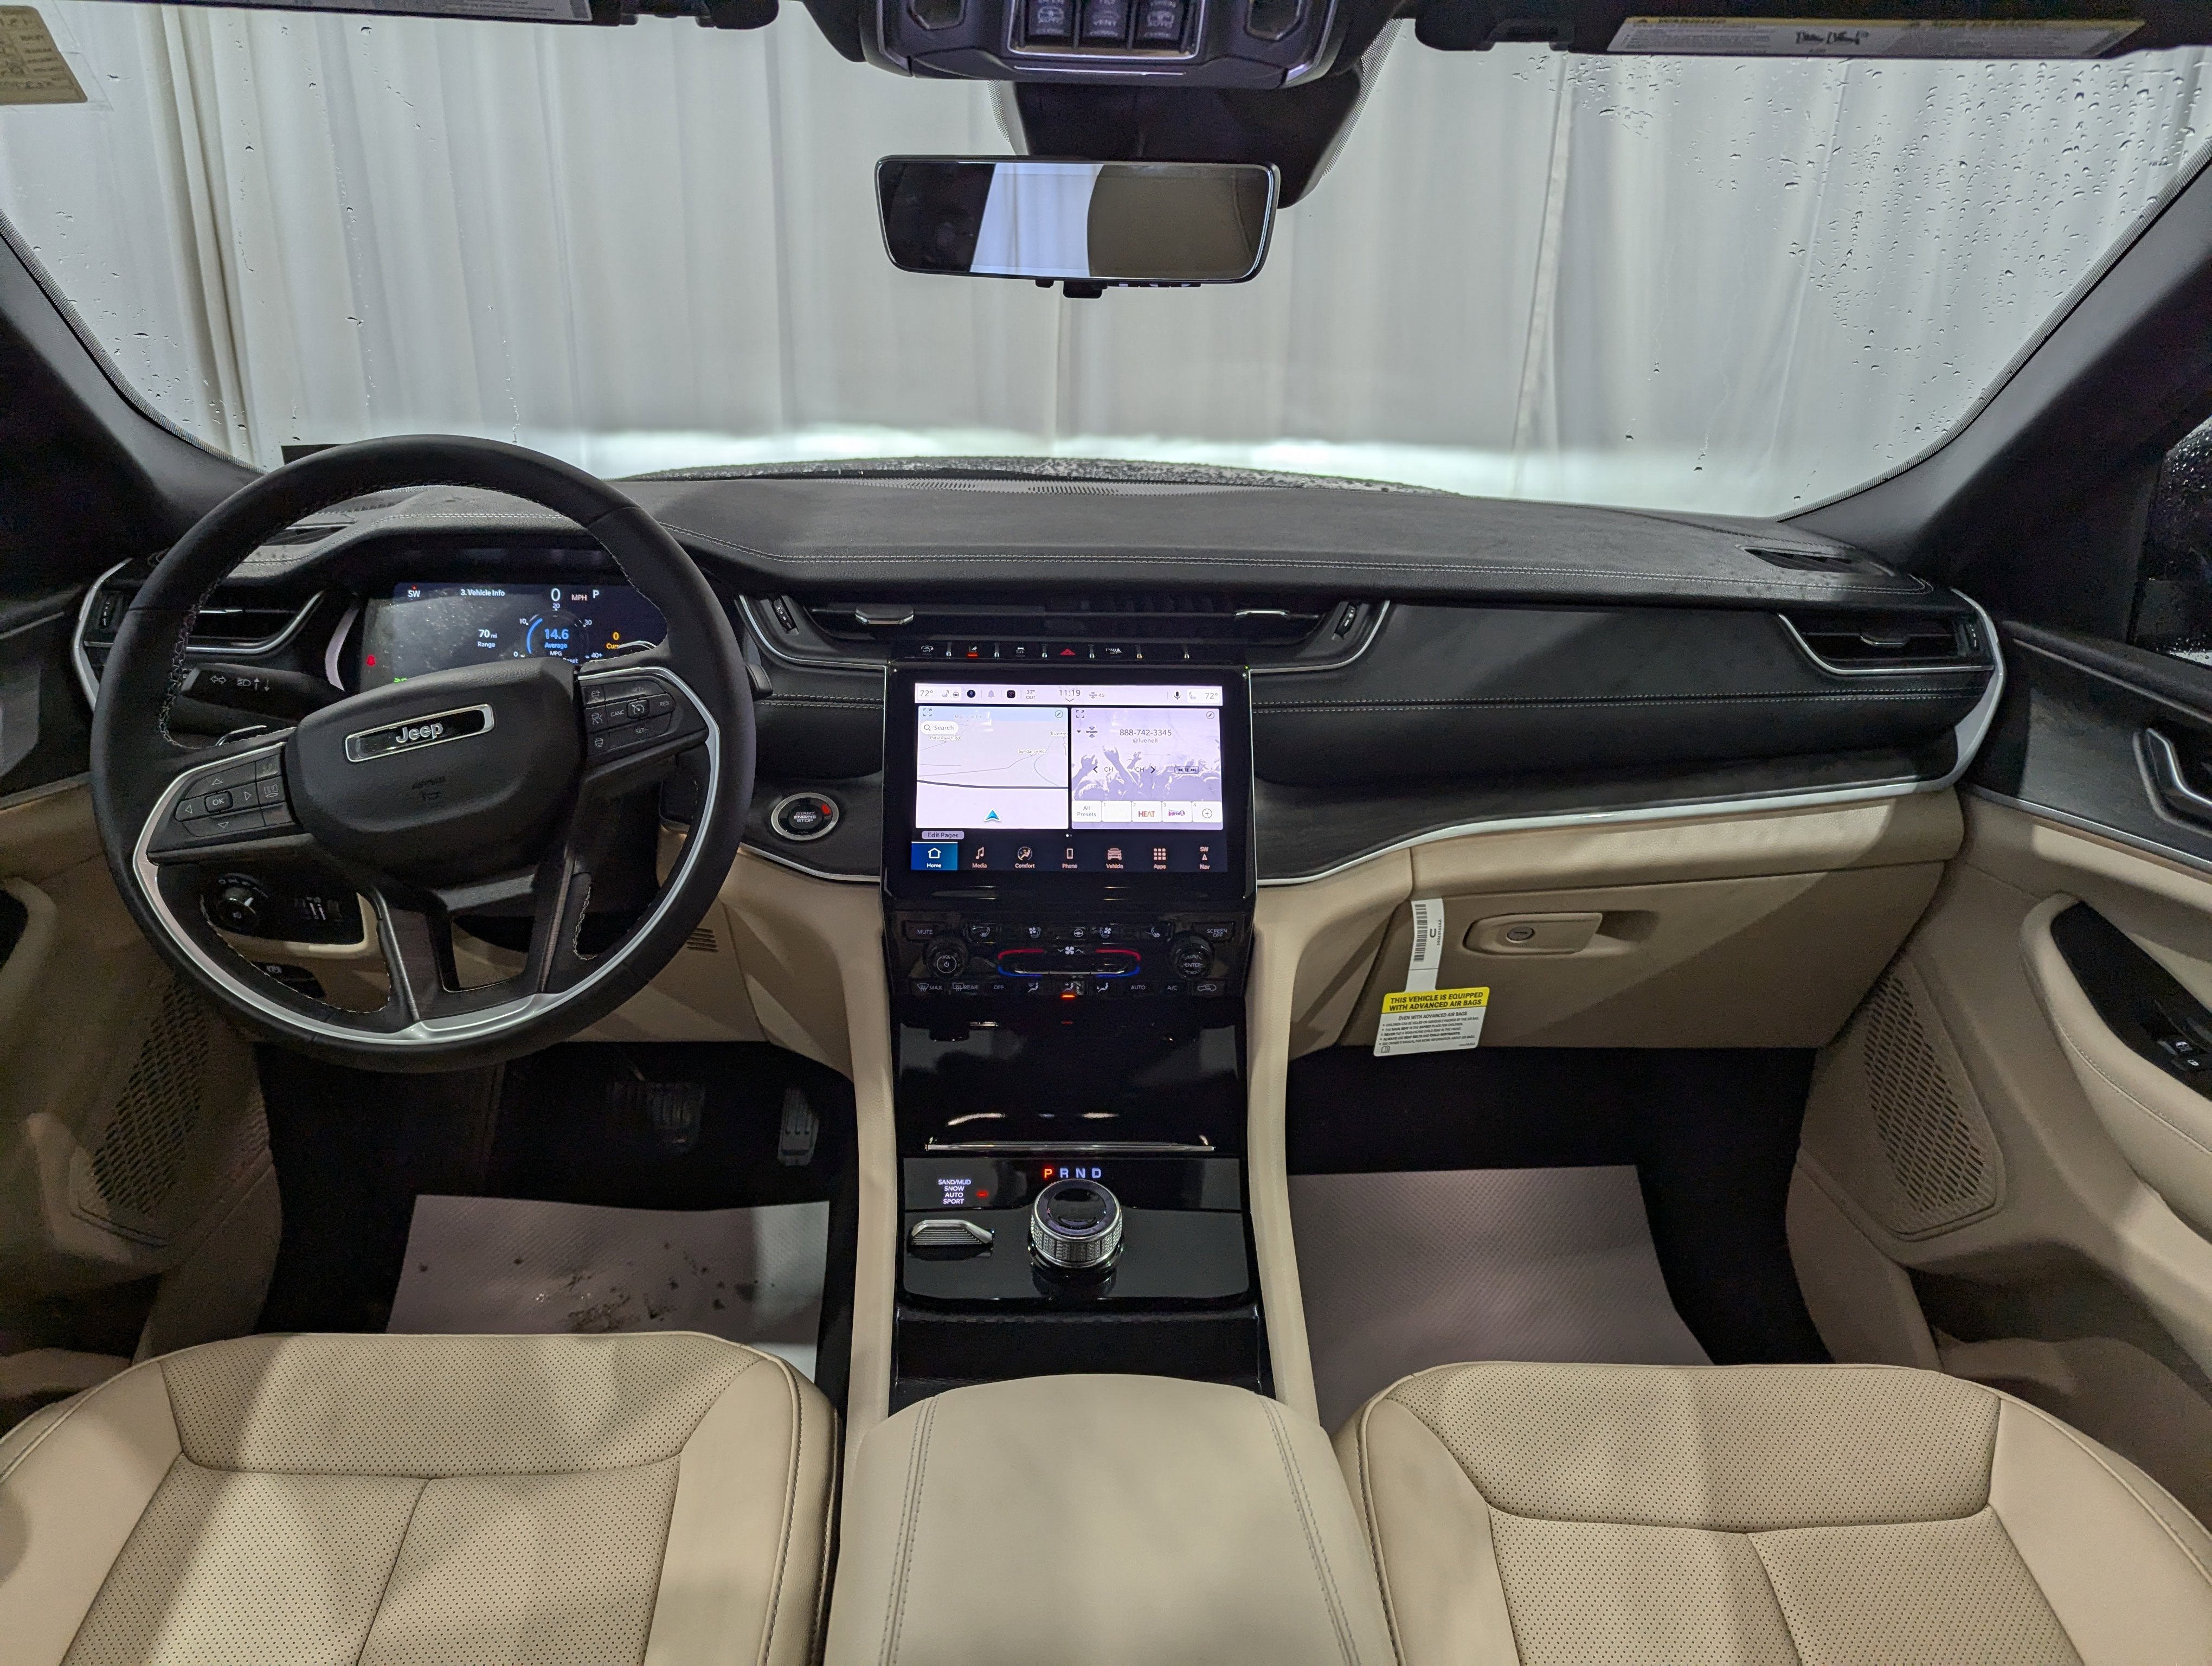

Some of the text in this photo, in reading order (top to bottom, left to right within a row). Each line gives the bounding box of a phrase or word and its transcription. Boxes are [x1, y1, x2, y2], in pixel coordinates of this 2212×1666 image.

[551, 588, 560, 601] 0
[593, 589, 599, 599] P
[478, 630, 490, 638] 70
[544, 629, 569, 639] 14.6
[613, 632, 619, 640] 0
[396, 722, 443, 744] Jeep
[212, 797, 224, 805] OK
[1429, 928, 1437, 938] U
[1408, 995, 1438, 1003] VEHICLE
[1448, 992, 1483, 1000] EQUIPPED
[1409, 1001, 1448, 1010] ADVANCED
[1044, 1168, 1101, 1178] P R N D
